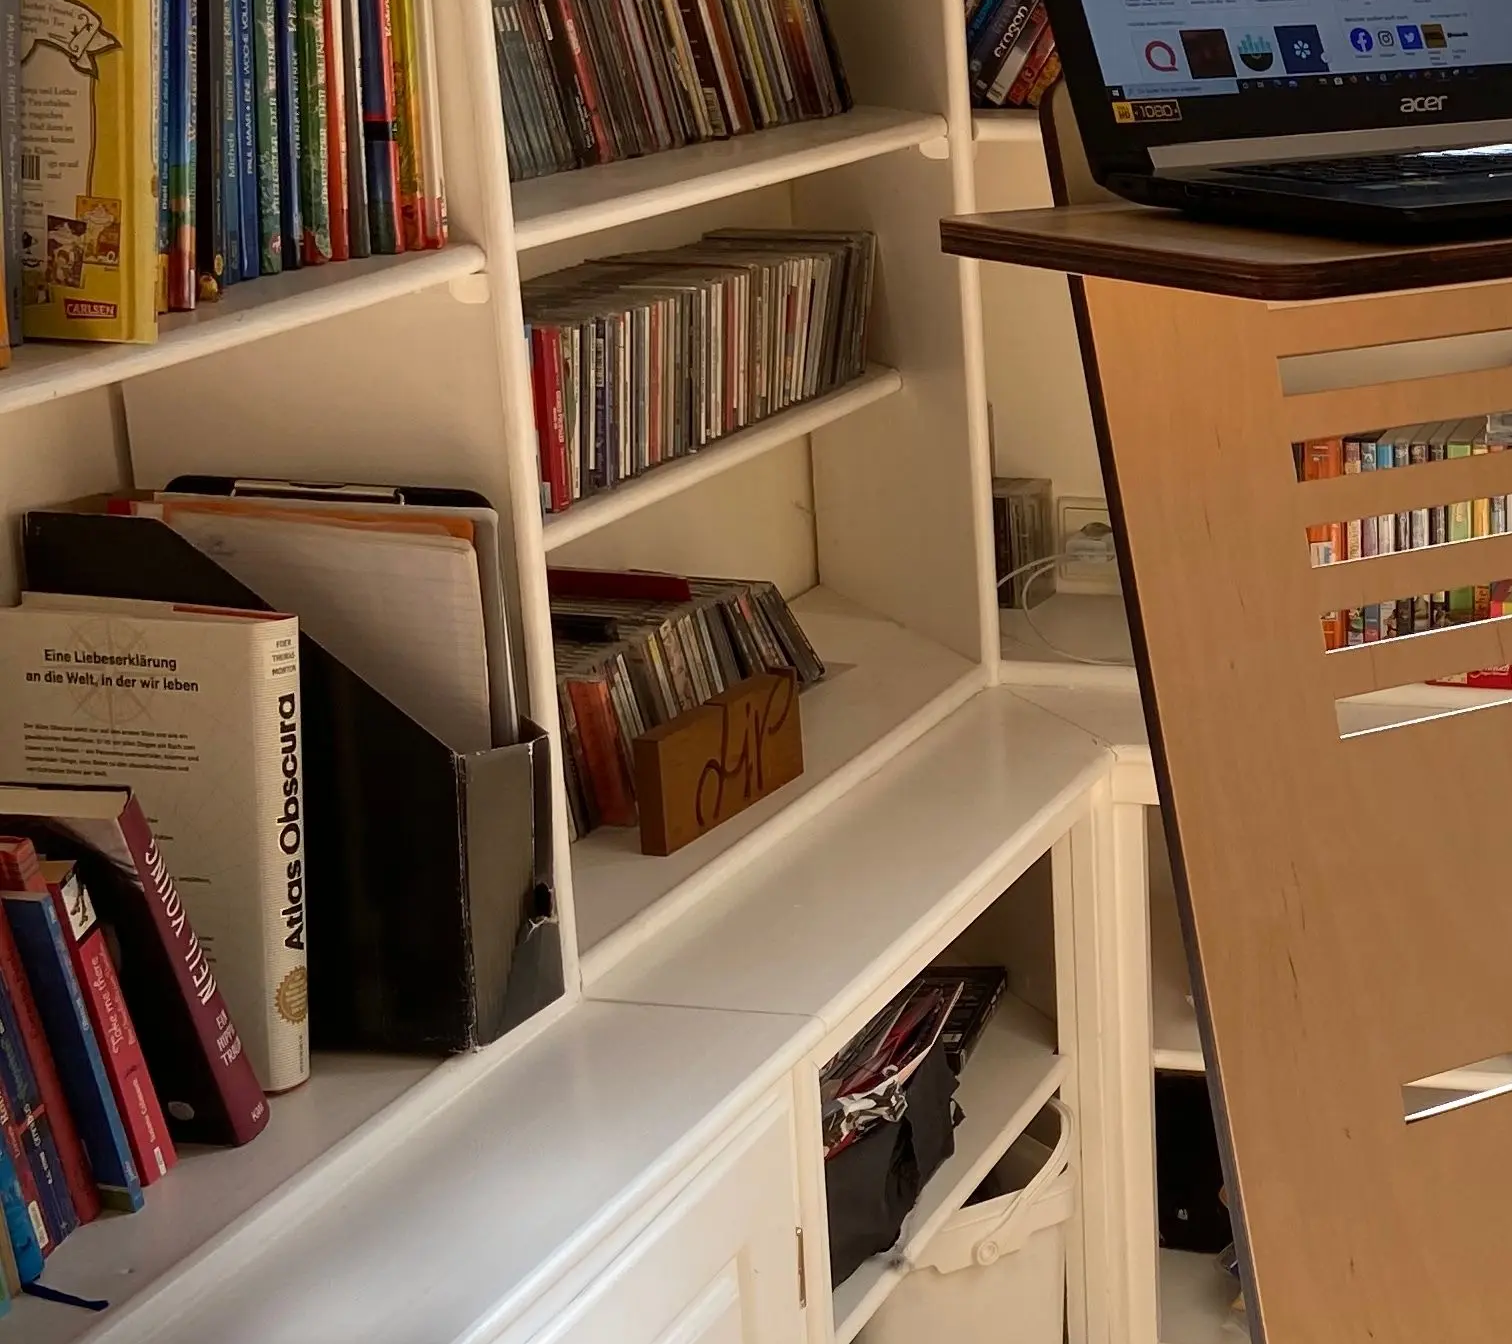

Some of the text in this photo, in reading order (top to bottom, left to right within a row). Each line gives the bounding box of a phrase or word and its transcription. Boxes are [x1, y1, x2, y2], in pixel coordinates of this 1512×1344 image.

[222, 5, 231, 35] Kalle
[994, 5, 1028, 57] eragon
[223, 40, 233, 75] König
[241, 32, 251, 74] WOCHE
[224, 79, 234, 120] Kleiner
[243, 78, 251, 102] EINE
[1400, 94, 1448, 113] acer
[1139, 104, 1173, 119] 1080
[244, 112, 252, 145] MAAR
[226, 132, 236, 177] Michels
[246, 148, 254, 174] PAUL
[66, 301, 116, 316] CARLSEN
[44, 648, 177, 672] Eine Liebeserklärung
[26, 671, 199, 692] an die Welt, in der wir leben
[277, 692, 305, 952] Atlas Obscura
[144, 837, 217, 1006] NEIL YOUNG
[84, 954, 129, 1054] Take me there
